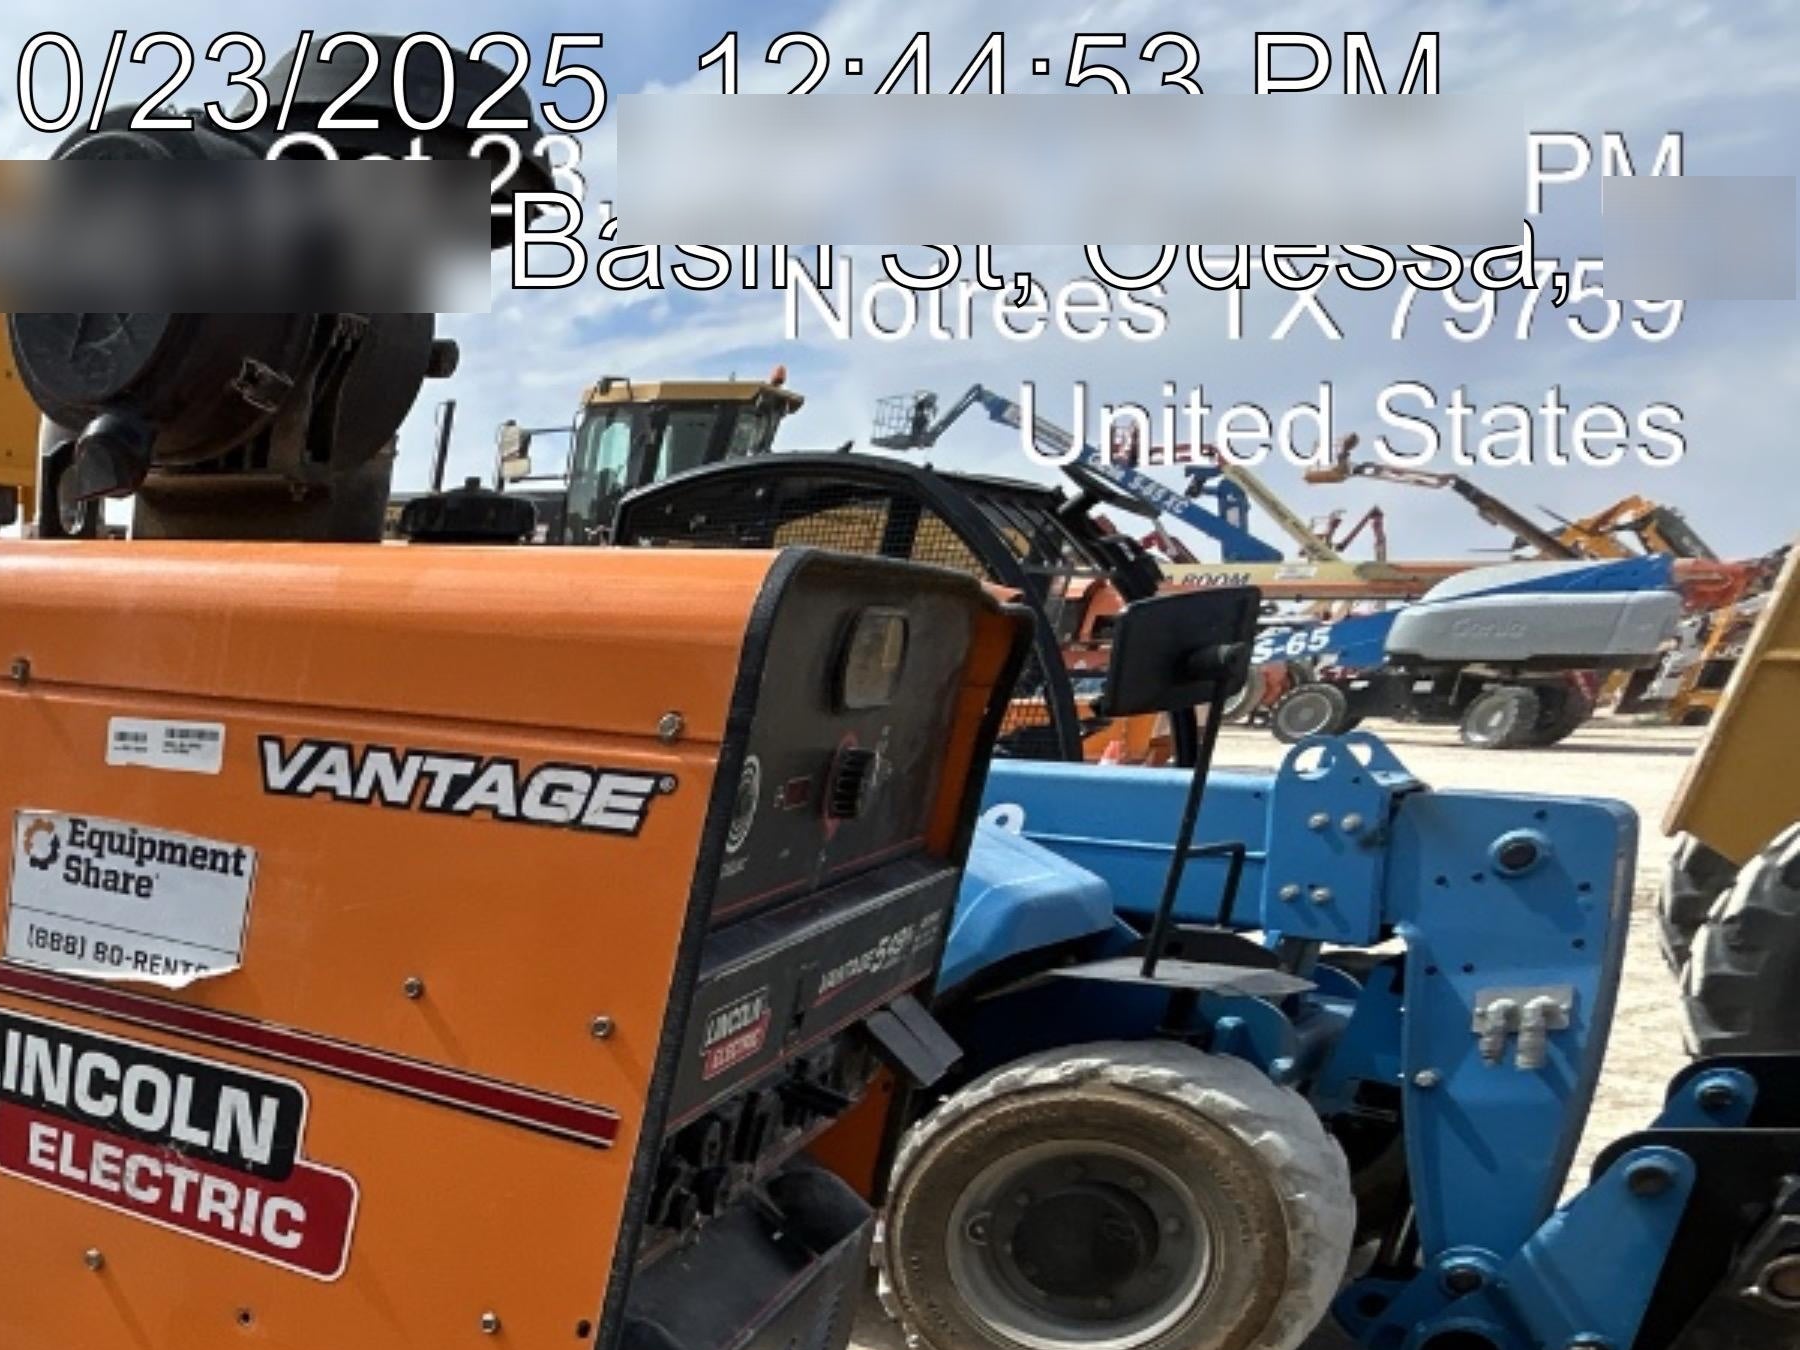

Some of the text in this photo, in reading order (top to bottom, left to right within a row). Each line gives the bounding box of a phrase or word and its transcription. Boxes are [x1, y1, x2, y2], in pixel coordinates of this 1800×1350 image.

[262, 739, 657, 832] VANTAGE
[63, 854, 154, 898] Share
[67, 817, 247, 877] Equipment
[28, 923, 87, 960] (888)
[27, 1120, 307, 1250] ELECTRIC
